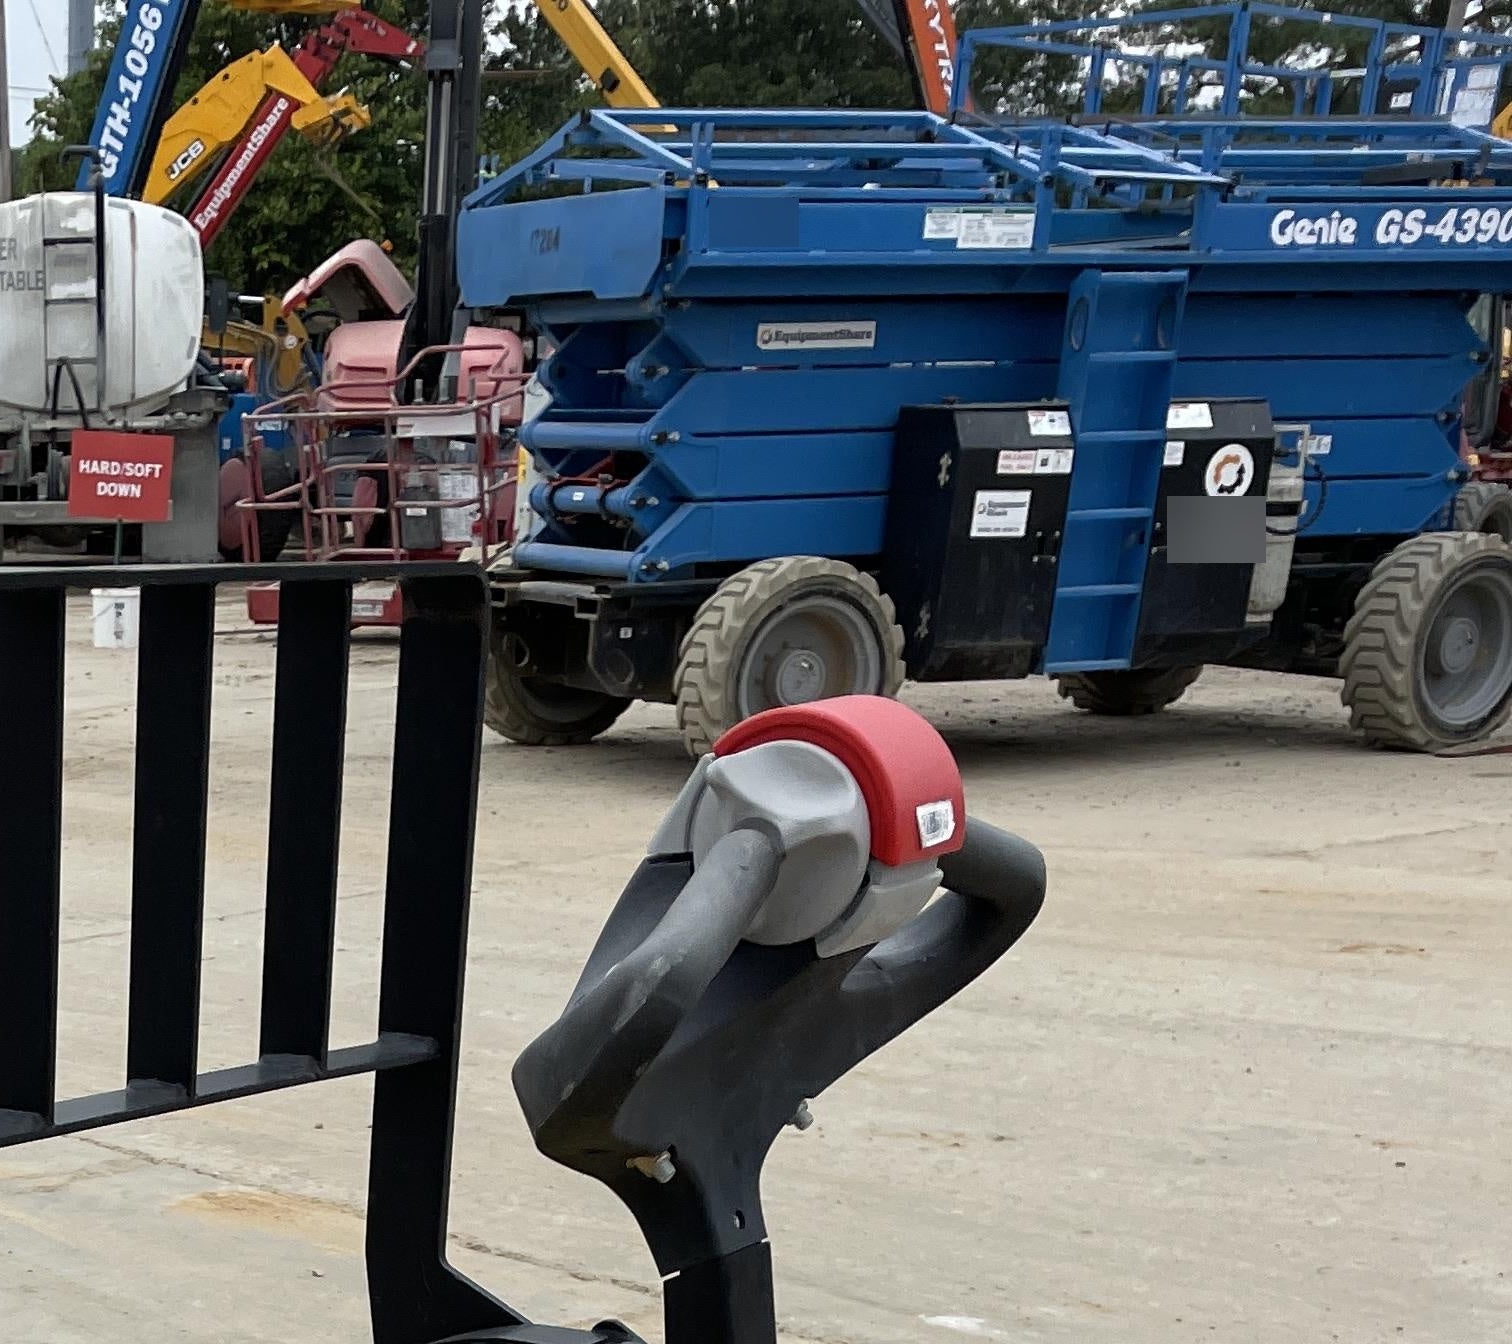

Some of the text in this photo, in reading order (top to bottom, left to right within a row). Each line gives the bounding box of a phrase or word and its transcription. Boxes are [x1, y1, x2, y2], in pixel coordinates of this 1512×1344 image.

[99, 3, 163, 179] GTH-1056
[168, 140, 205, 180] JCB
[194, 97, 289, 231] EquipmentShare
[1271, 208, 1358, 246] Genie
[79, 459, 163, 478] HARD/SOFT
[96, 481, 142, 498] DOWN
